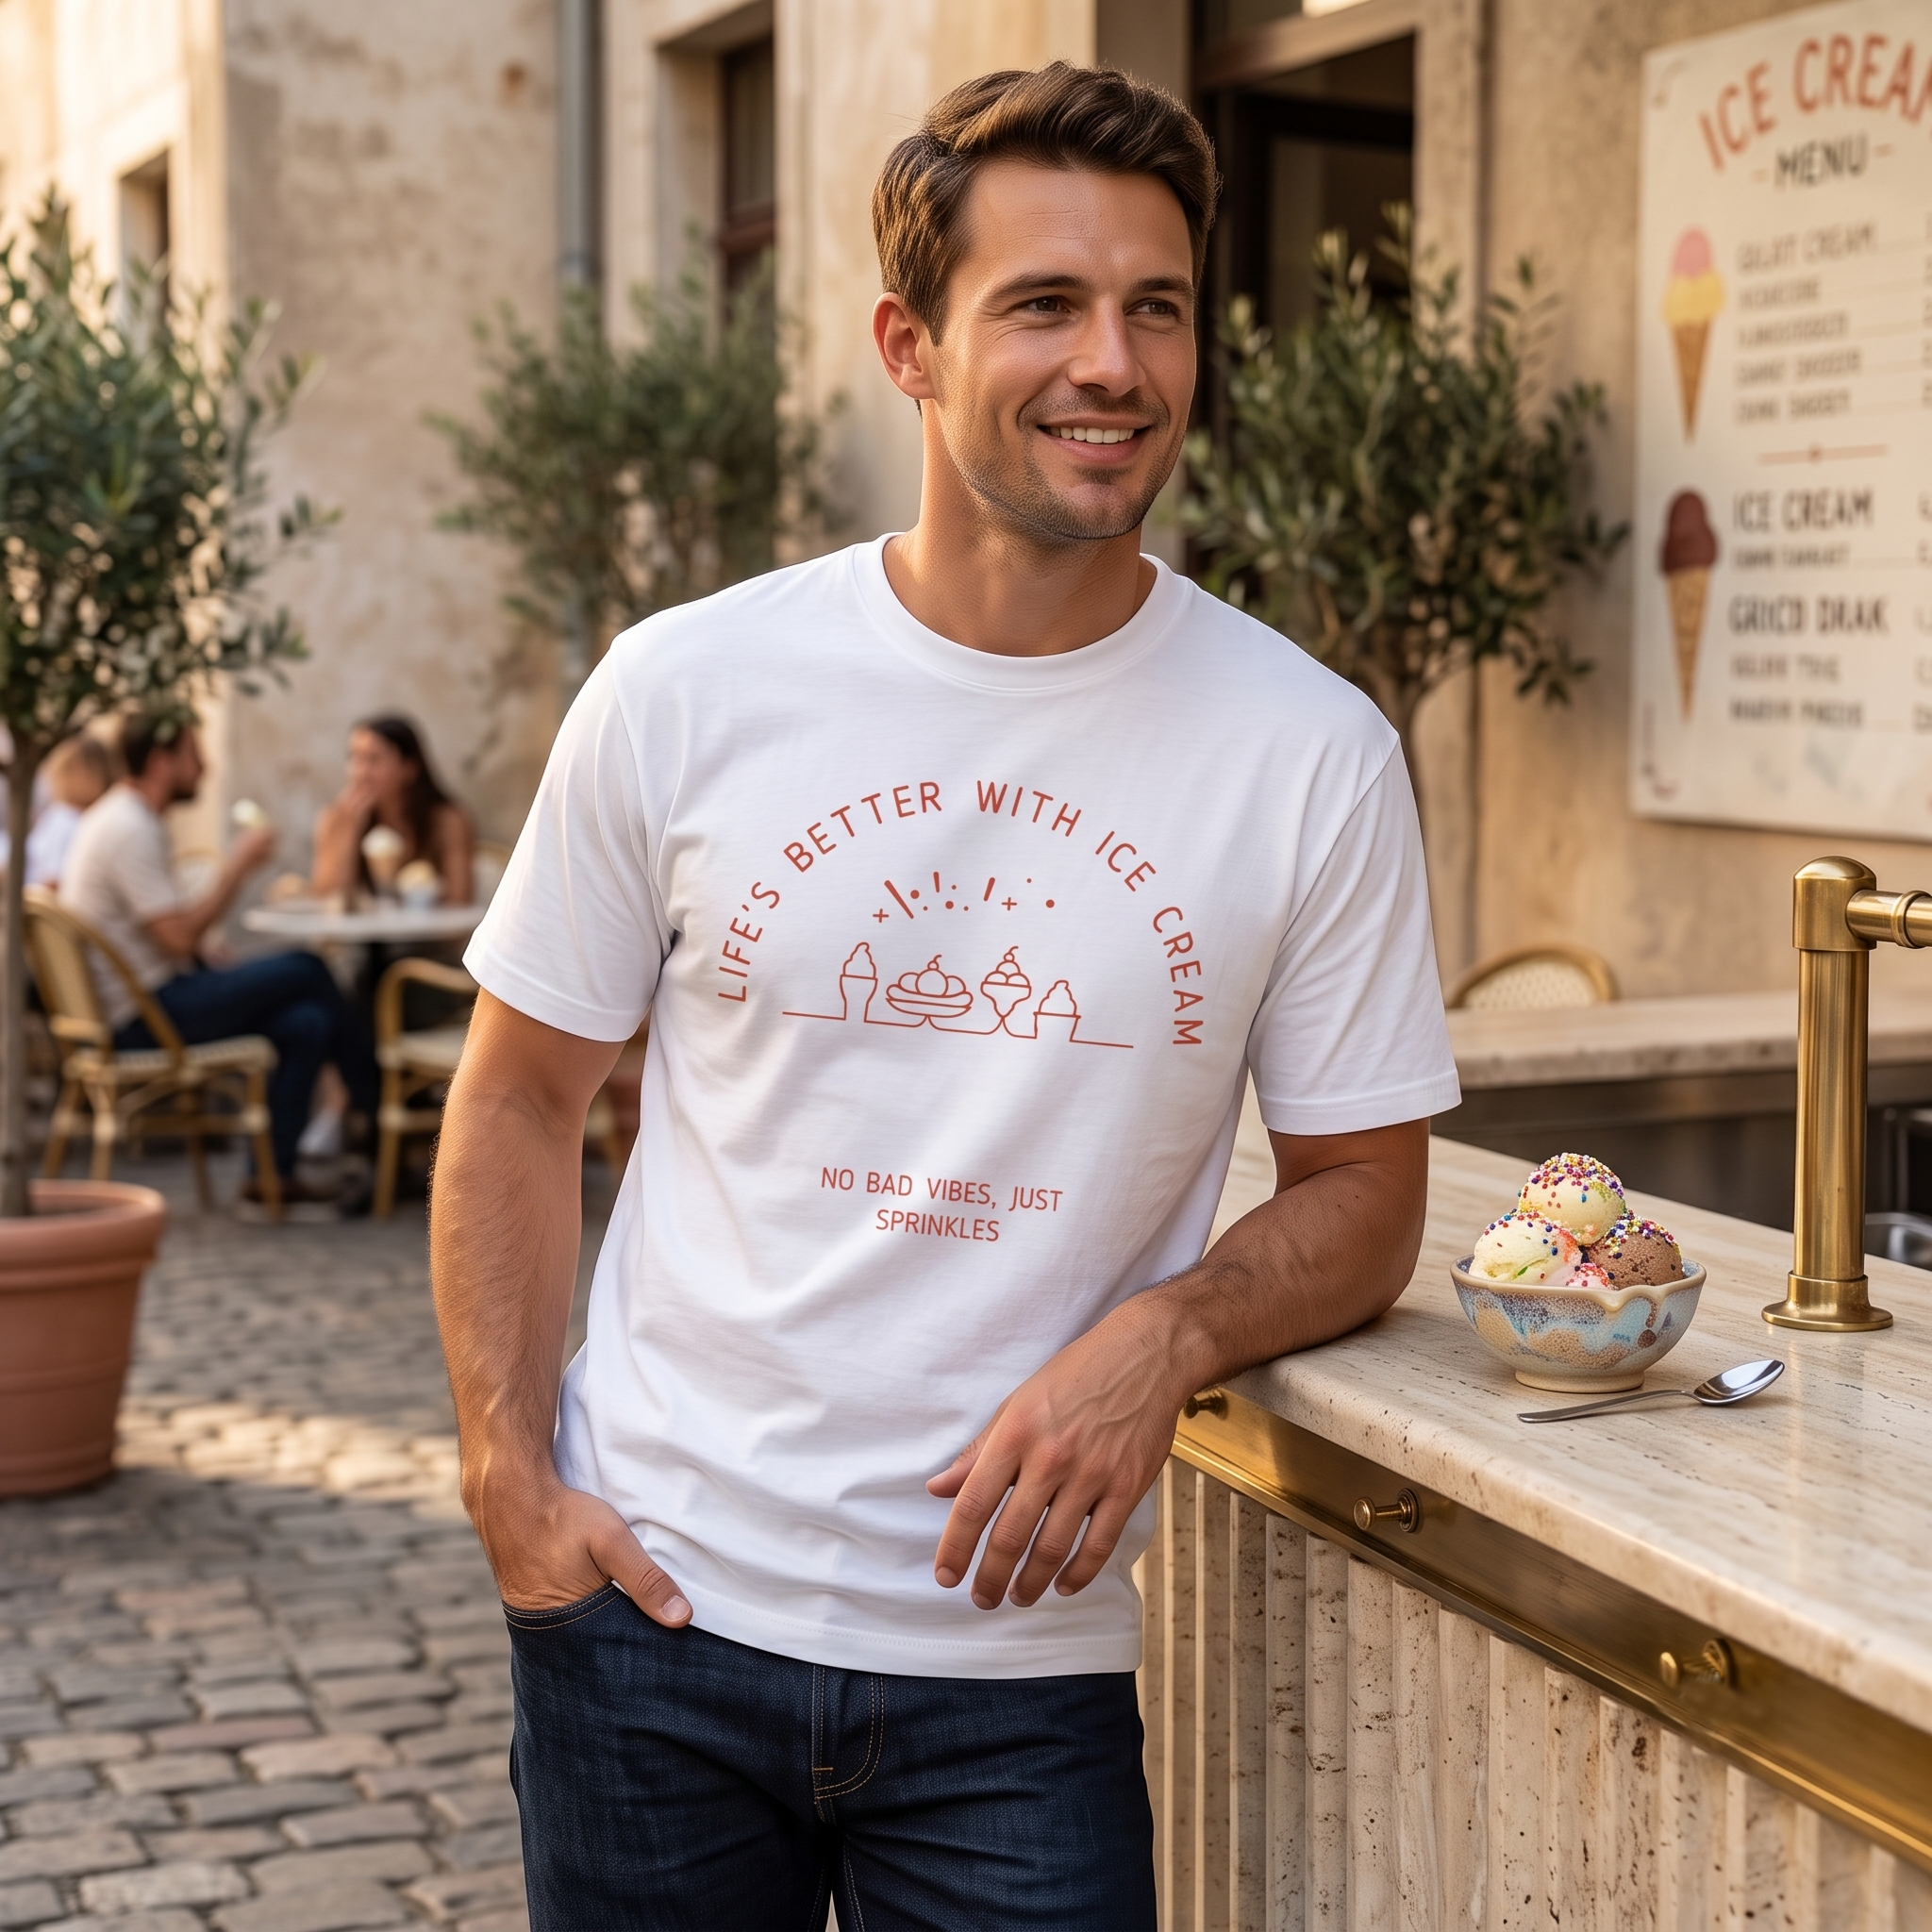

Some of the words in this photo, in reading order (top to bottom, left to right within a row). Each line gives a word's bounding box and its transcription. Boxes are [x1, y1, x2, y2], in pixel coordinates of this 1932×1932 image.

[1698, 59, 1777, 174] ICE
[1775, 132, 1869, 188] MENU
[1733, 489, 1773, 533] ICE
[1781, 486, 1874, 531] CREAM
[718, 882, 780, 1003] LIFE'S
[783, 781, 942, 873] BETTER
[976, 780, 1082, 837] WITH
[1095, 831, 1156, 891] ICE
[1152, 906, 1204, 1045] CREAM
[822, 1167, 855, 1191] NO
[866, 1171, 913, 1197] BAD
[927, 1178, 997, 1208] VIBES,
[1008, 1187, 1063, 1212] JUST
[875, 1208, 1000, 1242] SPRINKLES
